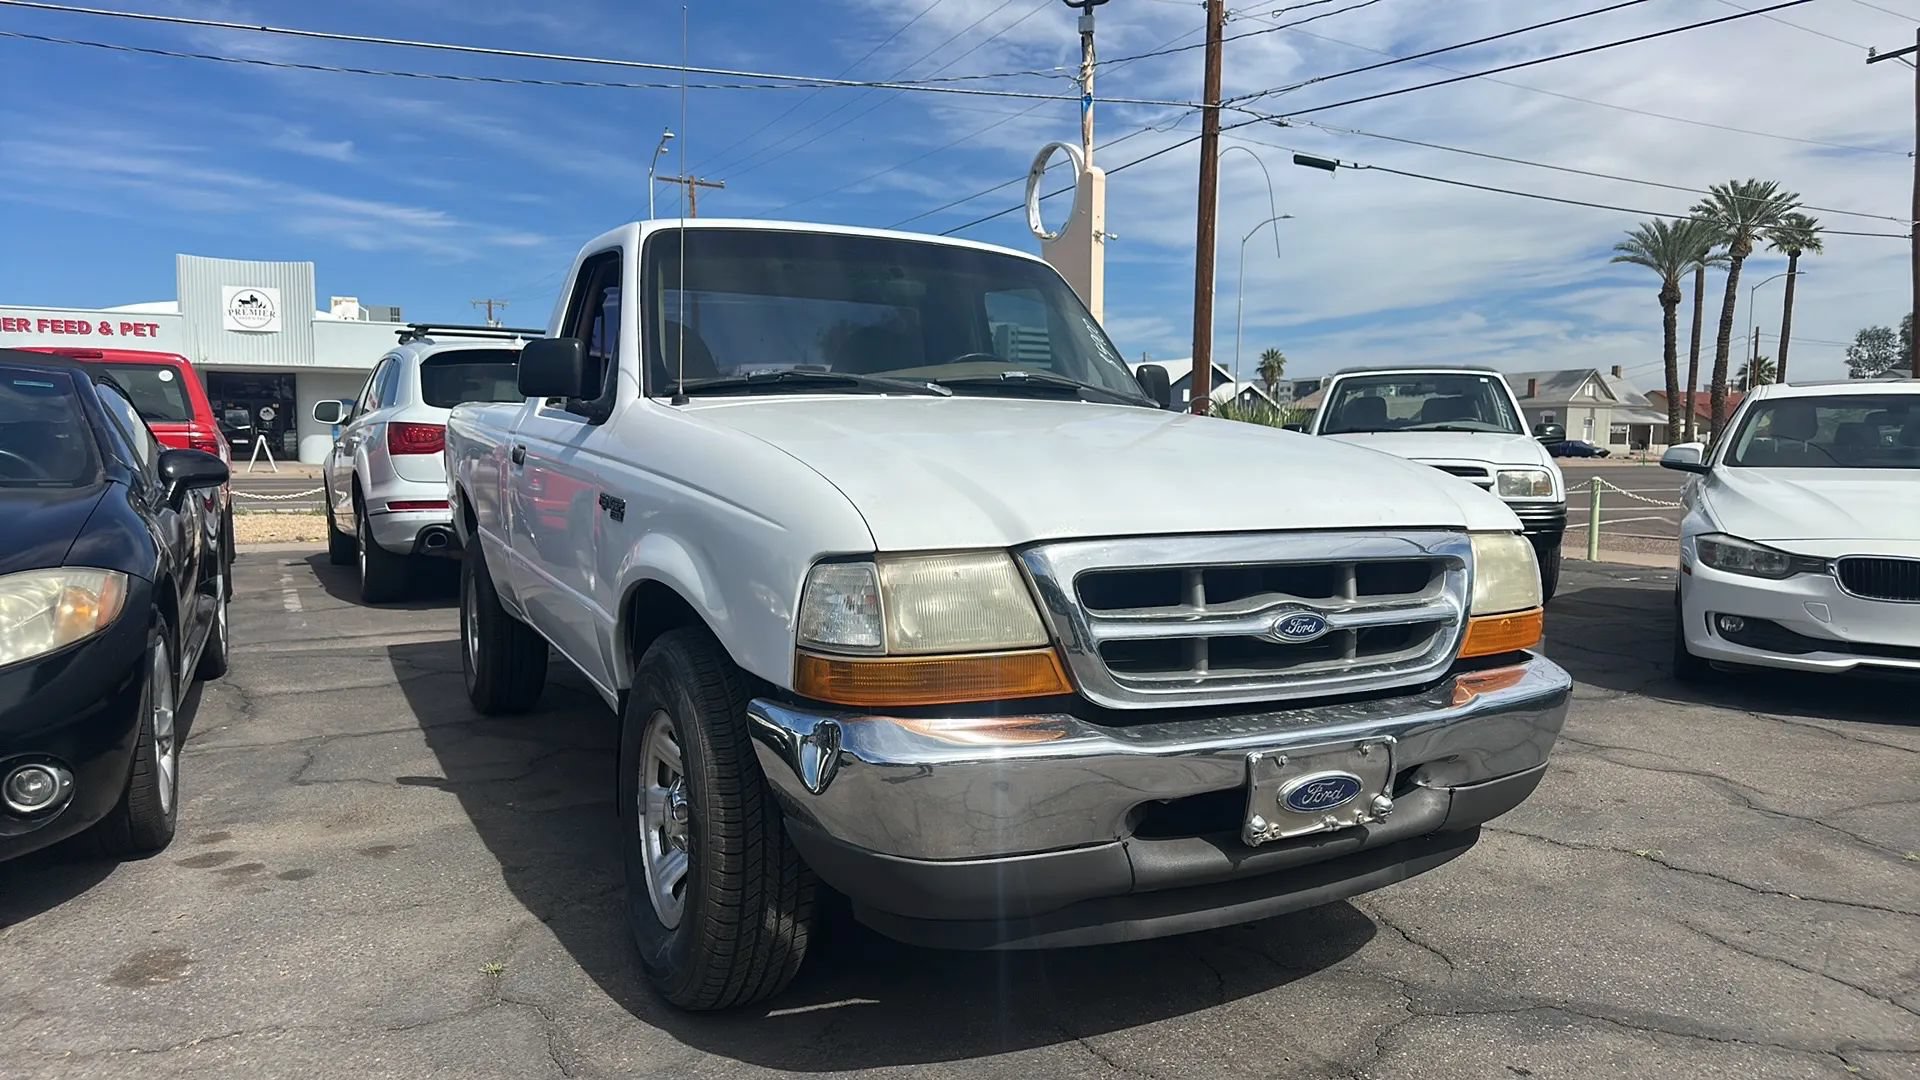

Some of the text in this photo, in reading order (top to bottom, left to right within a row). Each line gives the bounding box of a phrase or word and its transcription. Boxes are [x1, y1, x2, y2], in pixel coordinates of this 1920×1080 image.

[228, 308, 276, 318] PREMIER
[37, 319, 92, 335] FEED
[98, 321, 114, 336] &
[120, 322, 160, 337] PET
[1285, 618, 1317, 634] Ford
[1301, 780, 1345, 804] Ford
